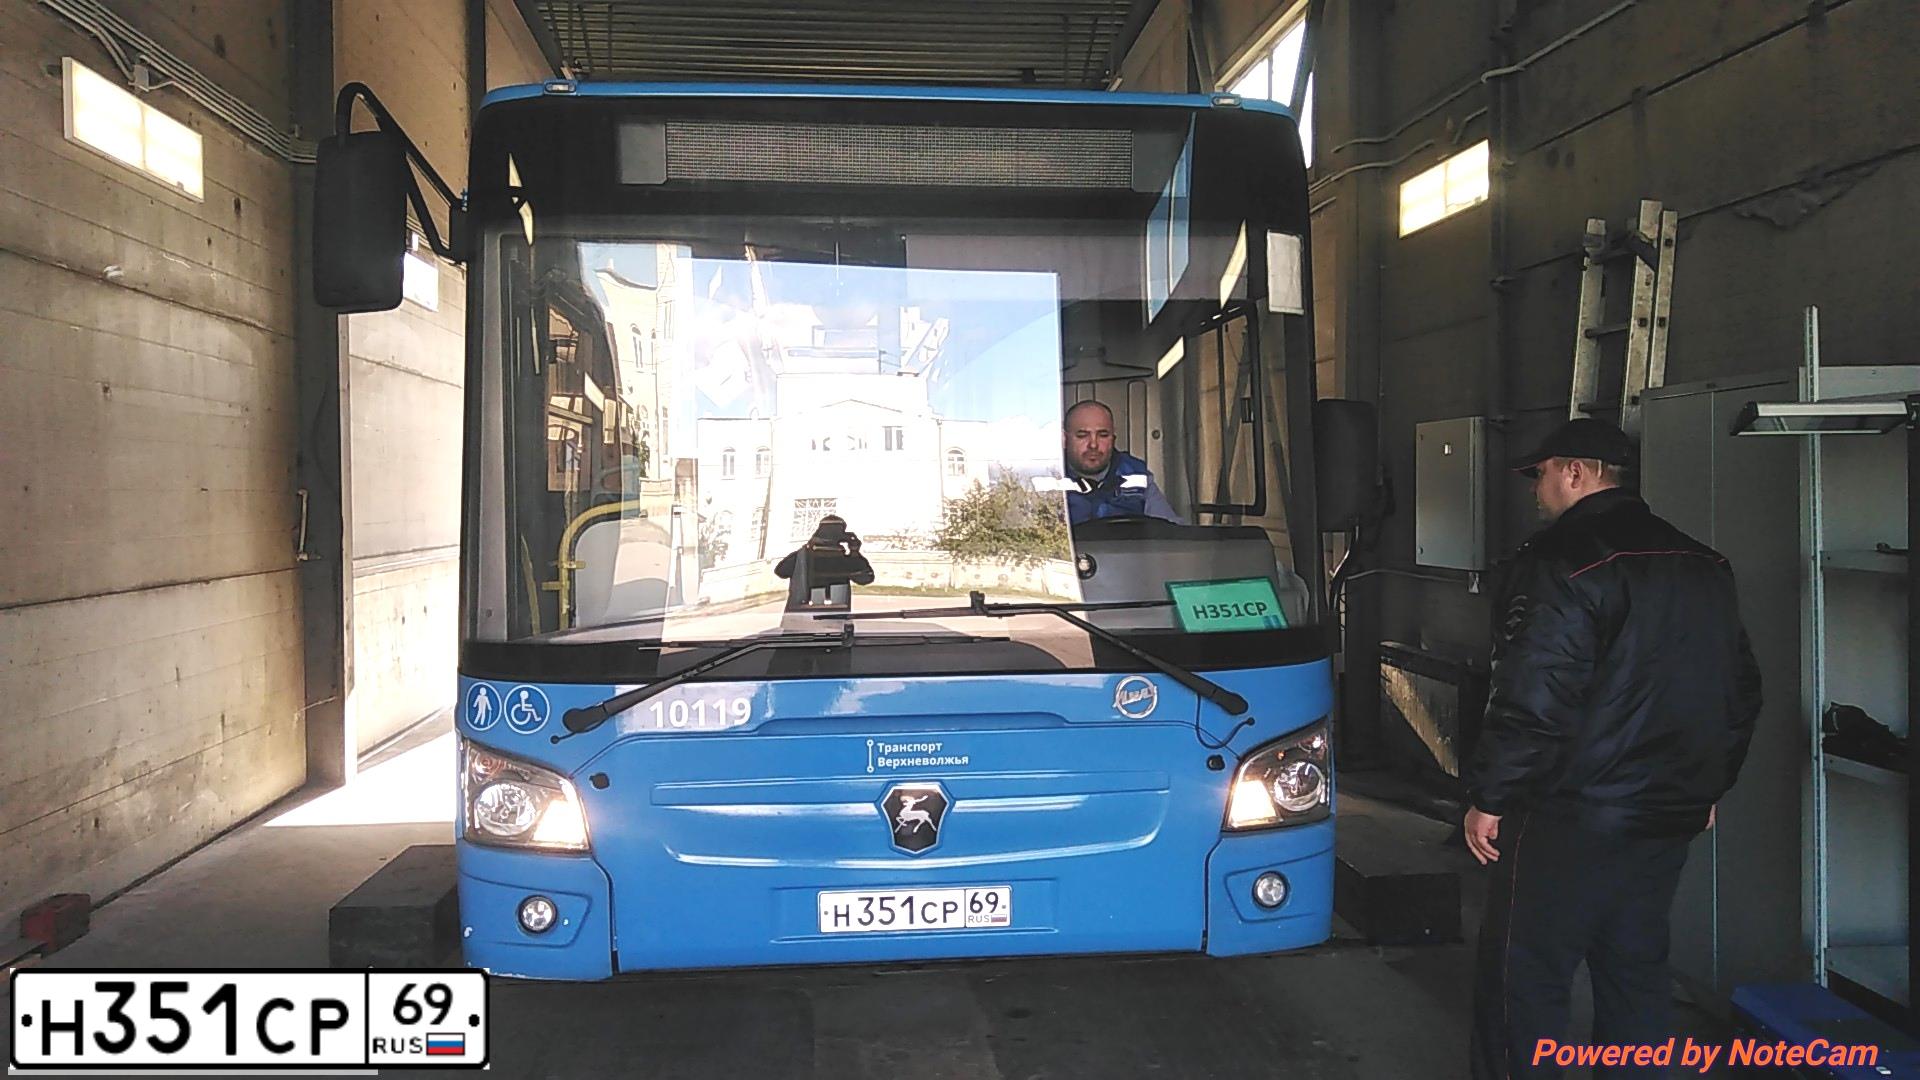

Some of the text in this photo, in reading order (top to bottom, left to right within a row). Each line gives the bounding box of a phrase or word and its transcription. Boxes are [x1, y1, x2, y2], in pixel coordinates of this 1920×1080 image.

[1192, 602, 1268, 619] Н351СР
[650, 698, 751, 728] 10119
[877, 742, 943, 755] Транспорт
[878, 756, 969, 769] Верхневолжья
[834, 891, 999, 927] Н351СР 69
[967, 914, 990, 924] RUS
